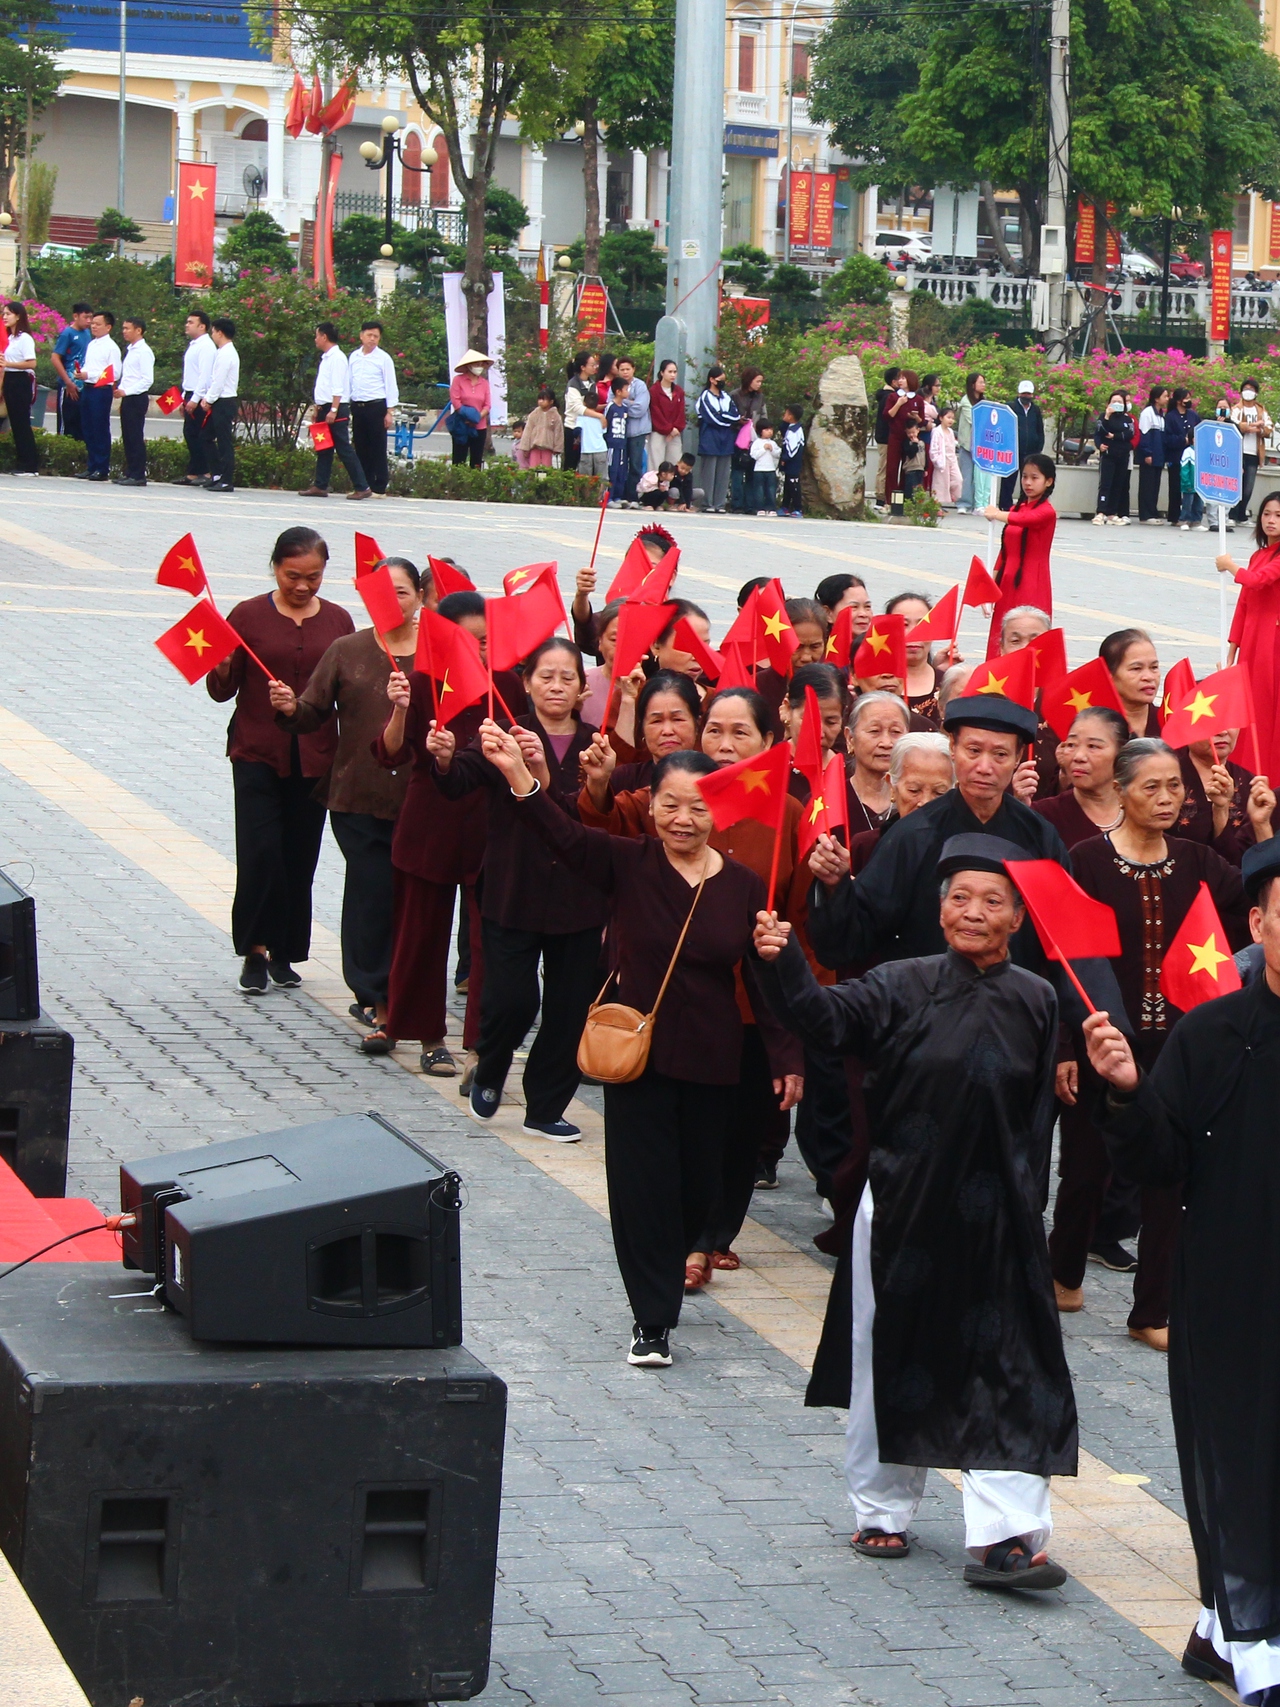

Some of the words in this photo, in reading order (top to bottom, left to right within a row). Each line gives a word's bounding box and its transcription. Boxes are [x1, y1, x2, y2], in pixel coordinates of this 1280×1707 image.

[985, 427, 1004, 445] KHỐI
[976, 445, 995, 464] PHỤ
[996, 449, 1014, 465] NỮ
[1209, 449, 1230, 468] KHỐI
[1200, 472, 1212, 489] HỌC
[1212, 474, 1225, 489] SINH
[1225, 475, 1239, 492] THCS
